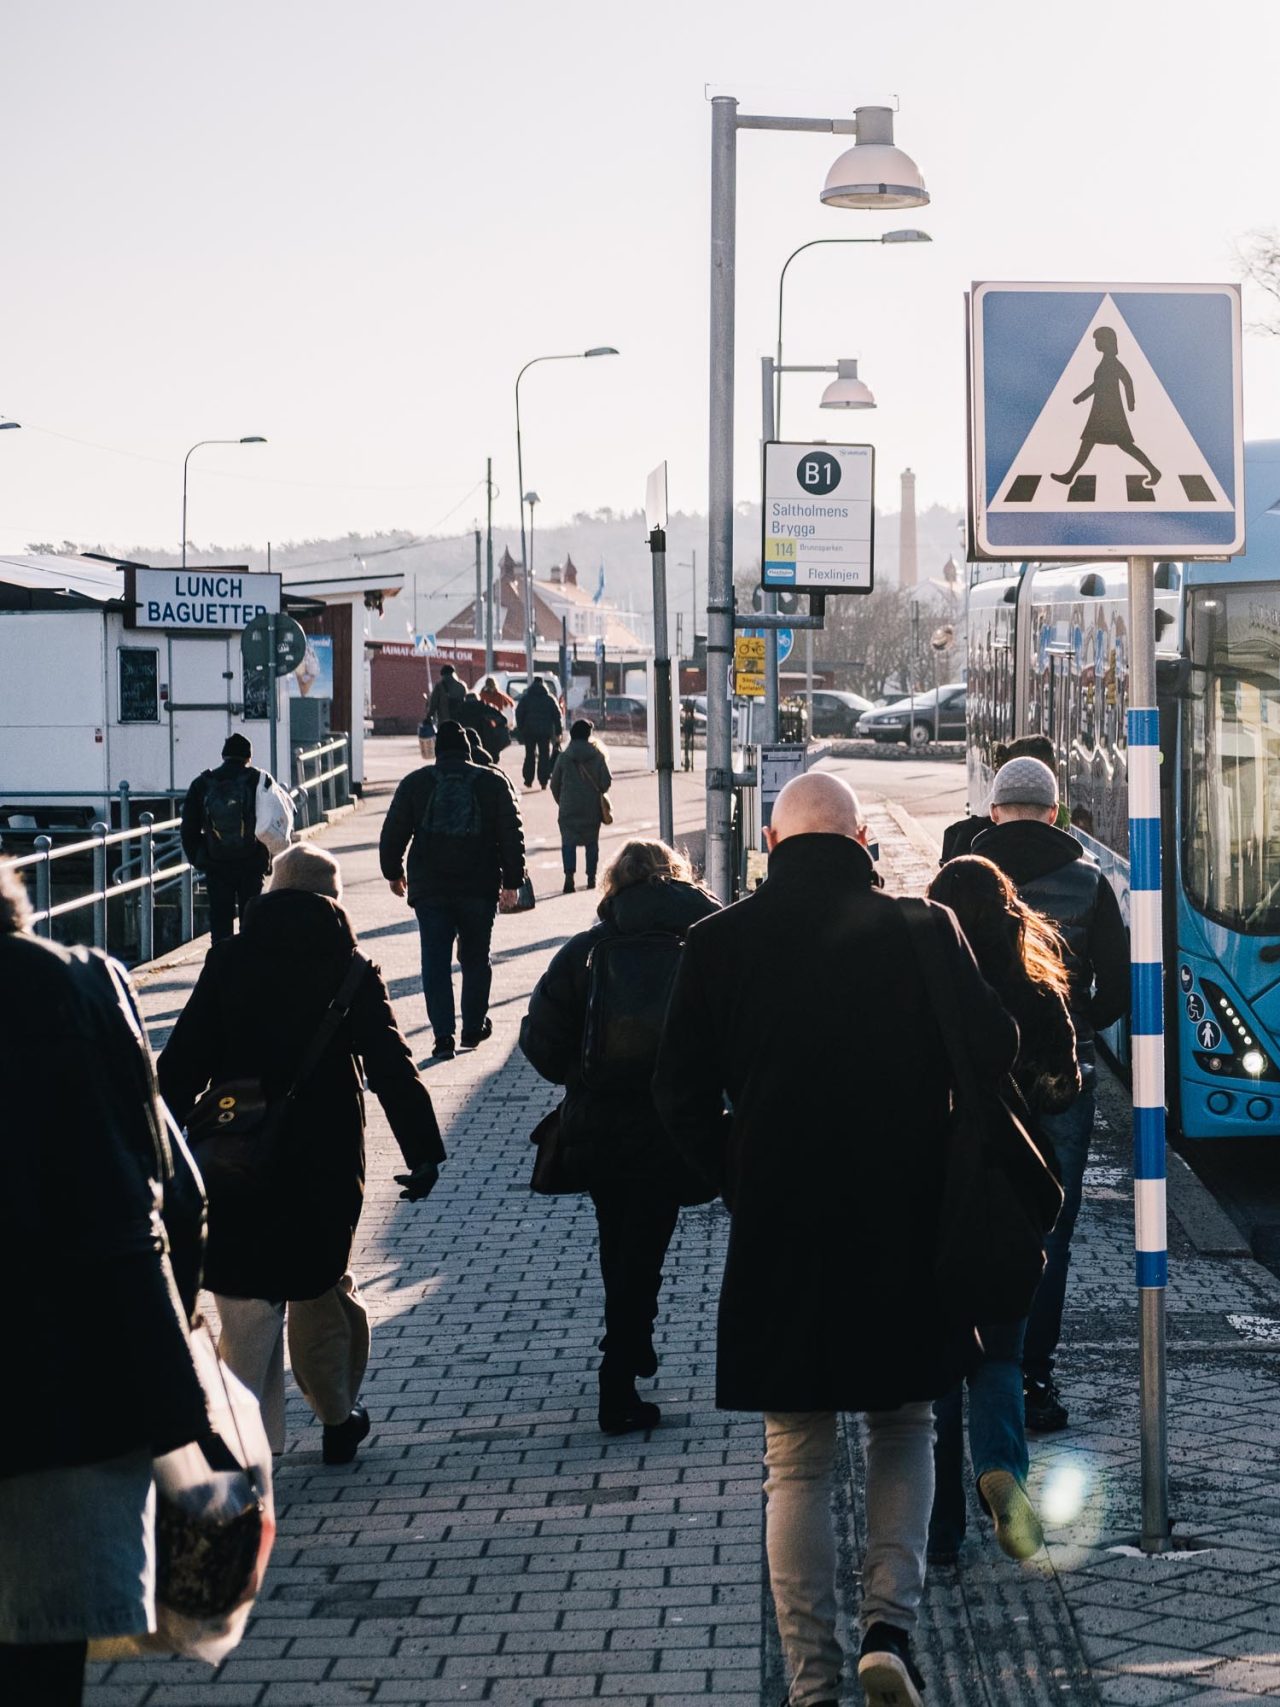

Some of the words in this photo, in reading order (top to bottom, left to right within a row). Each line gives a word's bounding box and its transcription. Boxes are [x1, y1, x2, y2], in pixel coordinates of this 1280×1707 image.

[805, 462, 832, 486] B1
[772, 503, 849, 518] Saltholmens
[772, 521, 816, 537] Brygga
[775, 543, 794, 557] 114
[808, 568, 860, 582] Flexlinjen
[175, 576, 243, 598] LUNCH
